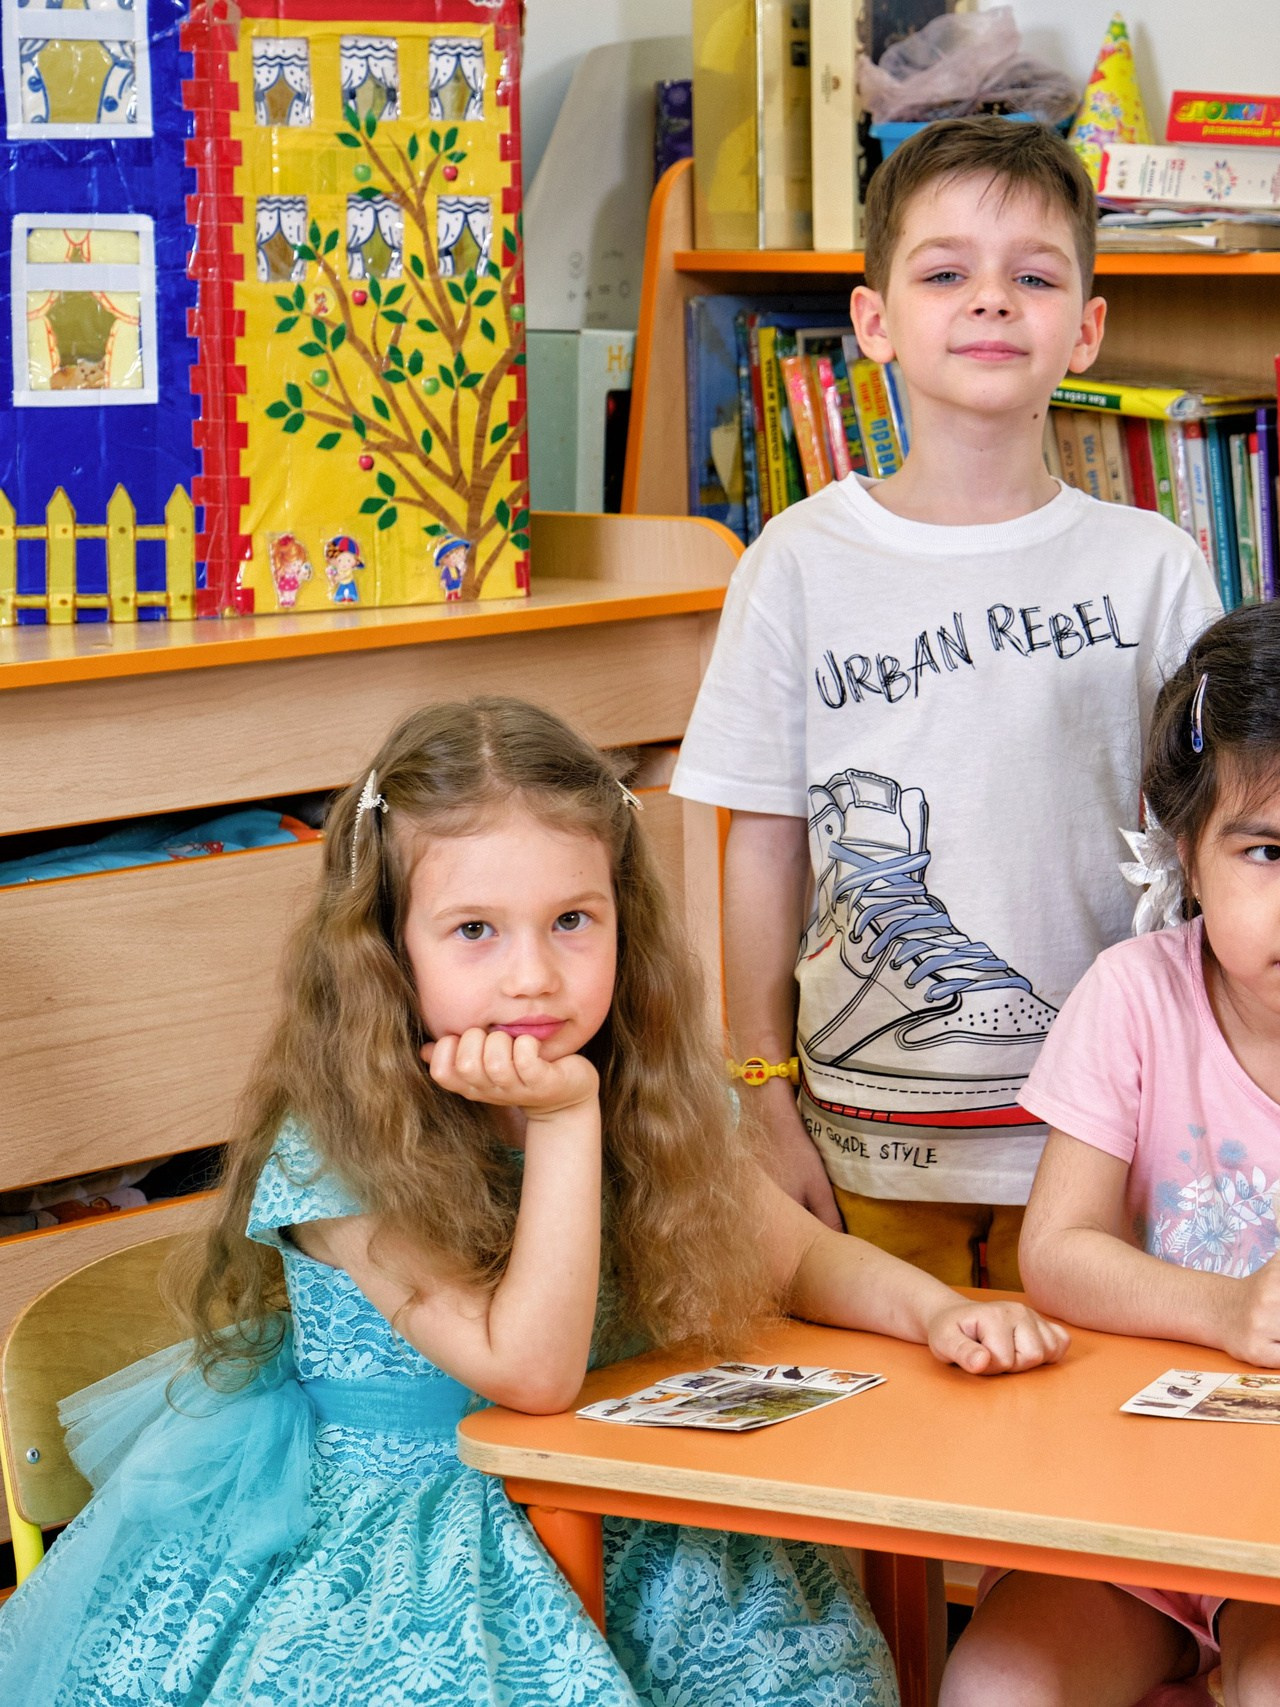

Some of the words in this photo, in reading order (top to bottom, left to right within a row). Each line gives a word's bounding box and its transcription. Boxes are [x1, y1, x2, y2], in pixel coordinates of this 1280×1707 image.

[1202, 125, 1273, 137] развивающая
[815, 612, 976, 709] URBAN
[987, 594, 1140, 660] REBEL
[826, 1126, 870, 1159] GRADE
[880, 1141, 938, 1168] STYLE
